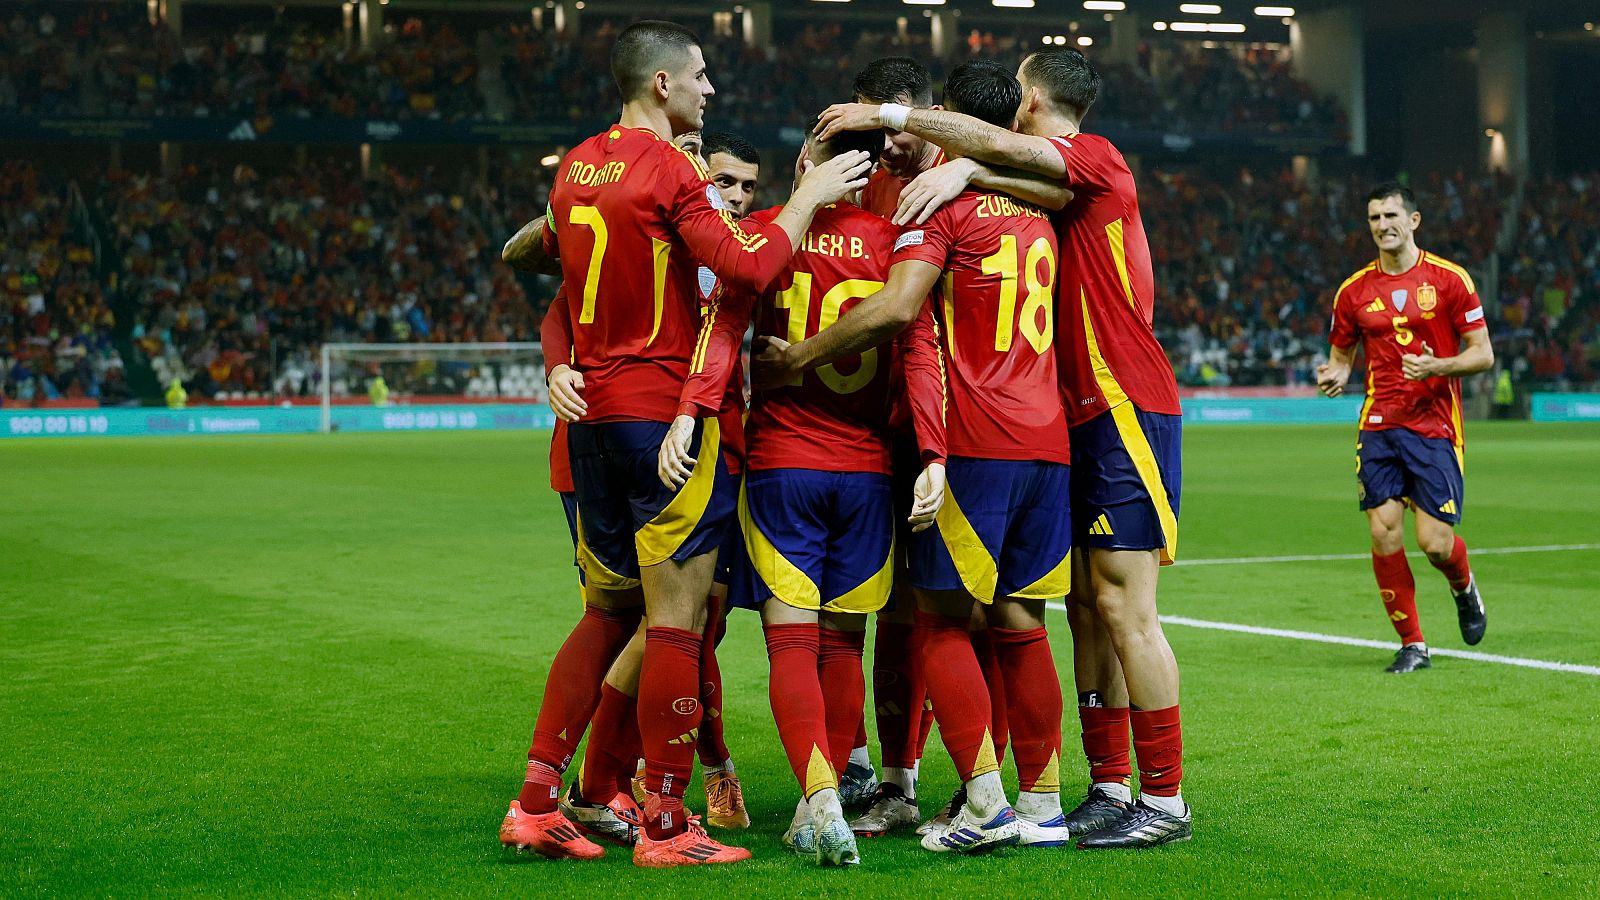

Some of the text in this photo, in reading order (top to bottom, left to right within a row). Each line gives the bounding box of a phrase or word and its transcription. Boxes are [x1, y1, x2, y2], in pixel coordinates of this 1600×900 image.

[850, 236, 869, 259] B.
[569, 206, 608, 324] 7
[981, 234, 1055, 355] 18
[1392, 316, 1413, 346] 5
[1089, 693, 1096, 707] 6
